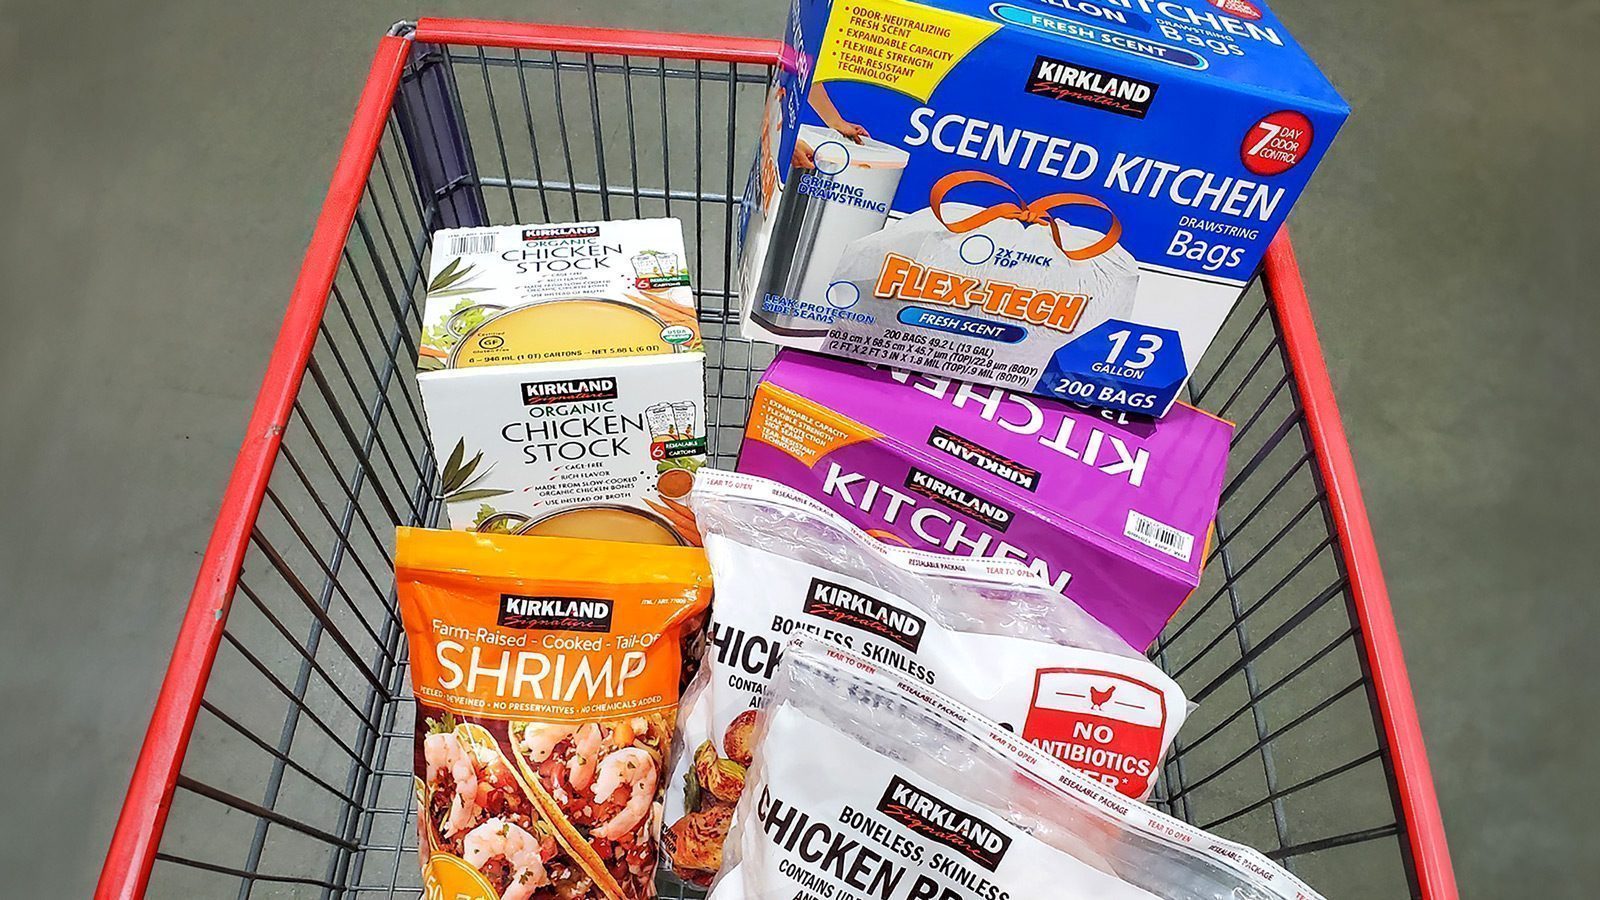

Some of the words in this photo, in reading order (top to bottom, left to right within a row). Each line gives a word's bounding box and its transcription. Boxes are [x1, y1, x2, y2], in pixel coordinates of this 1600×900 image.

[850, 16, 880, 33] FRESH
[881, 23, 911, 39] SCENT
[852, 6, 951, 38] ODOR-NEUTRALIZING
[1031, 15, 1095, 39] FRESH
[1101, 33, 1167, 56] SCENT
[1156, 18, 1234, 42] DRAWSTRING
[842, 39, 884, 59] FLEXIBLE
[885, 49, 934, 70] STRENGTH
[846, 27, 907, 51] EXPANDABLE
[909, 41, 954, 62] CAPACITY
[1160, 24, 1244, 56] Bags
[837, 61, 899, 84] TECHNOLOGY
[839, 51, 915, 78] TEAR-RESISTANT
[1032, 80, 1144, 113] Signature
[1038, 61, 1151, 103] KIRKLAND
[1248, 121, 1281, 156] 7
[1280, 127, 1303, 139] DAY
[1270, 138, 1299, 151] ODOR
[904, 106, 1099, 182] SCENTED
[1104, 153, 1285, 222] KITCHEN
[1259, 147, 1295, 164] CONTROL
[798, 183, 886, 213] DRAWSTRING
[800, 174, 864, 197] GRIPPING
[526, 227, 597, 237] KIRKLAND
[526, 238, 597, 248] ORGANIC
[1179, 216, 1259, 240] DRAWSTRING
[502, 244, 622, 262] CHICKEN
[516, 257, 610, 274] STOCK
[994, 257, 1018, 268] TOP
[995, 247, 1014, 259] 2X
[1016, 251, 1052, 267] THICK
[1166, 230, 1246, 271] Bags
[874, 253, 1088, 333] FLEX-TECH
[762, 302, 790, 315] SIDE
[793, 308, 835, 324] SEAMS
[918, 313, 960, 331] FRESH
[961, 321, 1006, 338] SCENT
[829, 329, 848, 341] 60.9
[849, 335, 863, 344] cm
[865, 336, 872, 345] X
[872, 338, 891, 349] 68.5
[891, 342, 905, 352] cm
[907, 344, 915, 353] X
[915, 346, 934, 357] 45.7
[949, 352, 992, 368] (TOP)/22.8
[1008, 363, 1038, 377] (BODY)
[884, 329, 901, 340] 200
[901, 333, 928, 345] BAGS
[928, 337, 949, 349] 49.2
[949, 341, 955, 351] L
[956, 342, 973, 355] (13
[972, 346, 994, 359] GAL)
[1103, 329, 1164, 369] 13
[829, 341, 840, 350] (2
[840, 342, 852, 352] FT
[852, 345, 860, 354] X
[861, 346, 869, 355] 2
[869, 348, 881, 357] FT
[881, 350, 888, 359] 3
[889, 351, 900, 361] IN
[900, 353, 909, 362] X
[909, 355, 923, 366] 1.8
[923, 358, 940, 369] MIL
[977, 368, 994, 379] MIL
[1091, 362, 1145, 380] GALLON
[527, 380, 613, 396] KIRKLAND
[528, 392, 614, 404] Signature
[1054, 378, 1095, 398] 200
[1098, 386, 1158, 409] BAGS
[530, 401, 614, 418] ORGANIC
[768, 407, 797, 424] FLEXIBLE
[798, 421, 834, 442] STRENGTH
[769, 400, 813, 424] EXPANDABLE
[814, 421, 848, 440] CAPACITY
[501, 413, 644, 443] CHICKEN
[523, 438, 631, 465] STOCK
[565, 462, 603, 470] CAGE-FREE
[652, 446, 664, 457] 6
[932, 435, 1033, 489] KIRKLAND
[539, 488, 575, 497] ORGANIC
[576, 486, 609, 494] CHICKEN
[610, 483, 635, 491] BONES
[581, 471, 610, 479] FLAVOR
[561, 496, 591, 504] INSTEAD
[913, 471, 1009, 523] KIRKLAND
[506, 597, 609, 619] KIRKLAND
[814, 584, 920, 636] KIRKLAND
[432, 619, 527, 648] Farm-Raised
[542, 634, 602, 652] Cooked
[504, 616, 606, 631] Signature
[810, 603, 914, 647] Signature
[436, 641, 647, 702] SHRIMP
[826, 650, 843, 661] TEAR
[845, 656, 855, 666] TO
[857, 662, 876, 674] OPEN
[862, 642, 935, 686] SKINLESS
[493, 702, 507, 710] NO
[508, 702, 574, 714] PRESERVATIVES
[591, 701, 637, 712] CHEMICALS
[638, 696, 662, 706] ADDED
[897, 682, 937, 708] RESEALABLE
[937, 701, 968, 724] PACKAGE
[1073, 722, 1113, 743] NO
[989, 732, 1006, 745] TEAR
[1007, 743, 1017, 752] TO
[1018, 751, 1037, 764] OPEN
[1032, 739, 1150, 777] ANTIBIOTICS
[1059, 776, 1099, 799] RESEALABLE
[1098, 795, 1128, 816] PACKAGE
[883, 802, 993, 865] Signature
[891, 783, 1002, 854] KIRKLAND
[1148, 819, 1164, 830] TEAR
[1165, 827, 1174, 836] TO
[1174, 831, 1192, 842] OPEN
[757, 784, 906, 900] CHICKEN
[839, 805, 925, 866] BONELESS,
[779, 859, 835, 898] CONTAINS
[1242, 859, 1274, 881] PACKAGE
